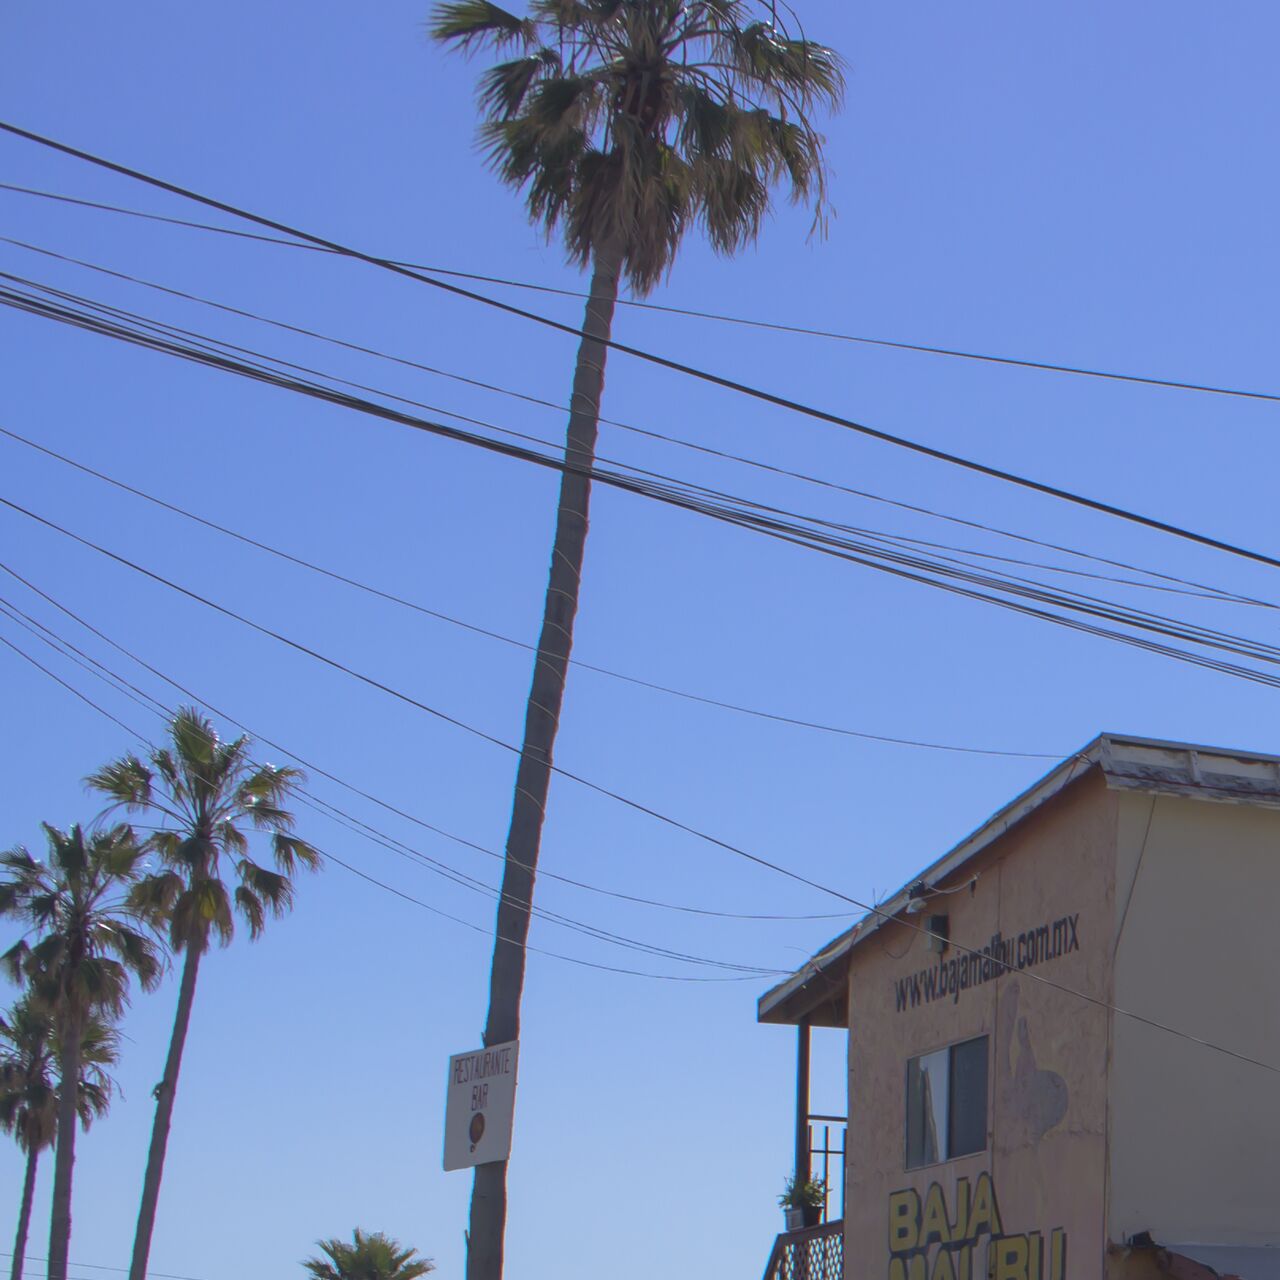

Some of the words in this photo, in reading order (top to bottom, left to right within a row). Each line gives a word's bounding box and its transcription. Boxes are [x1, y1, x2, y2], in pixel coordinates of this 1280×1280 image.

[895, 913, 1080, 1013] www.bajamalibu.com.mx
[454, 1047, 512, 1086] RESTAURANTE
[471, 1083, 489, 1112] BAR
[889, 1171, 1004, 1254] BAJA
